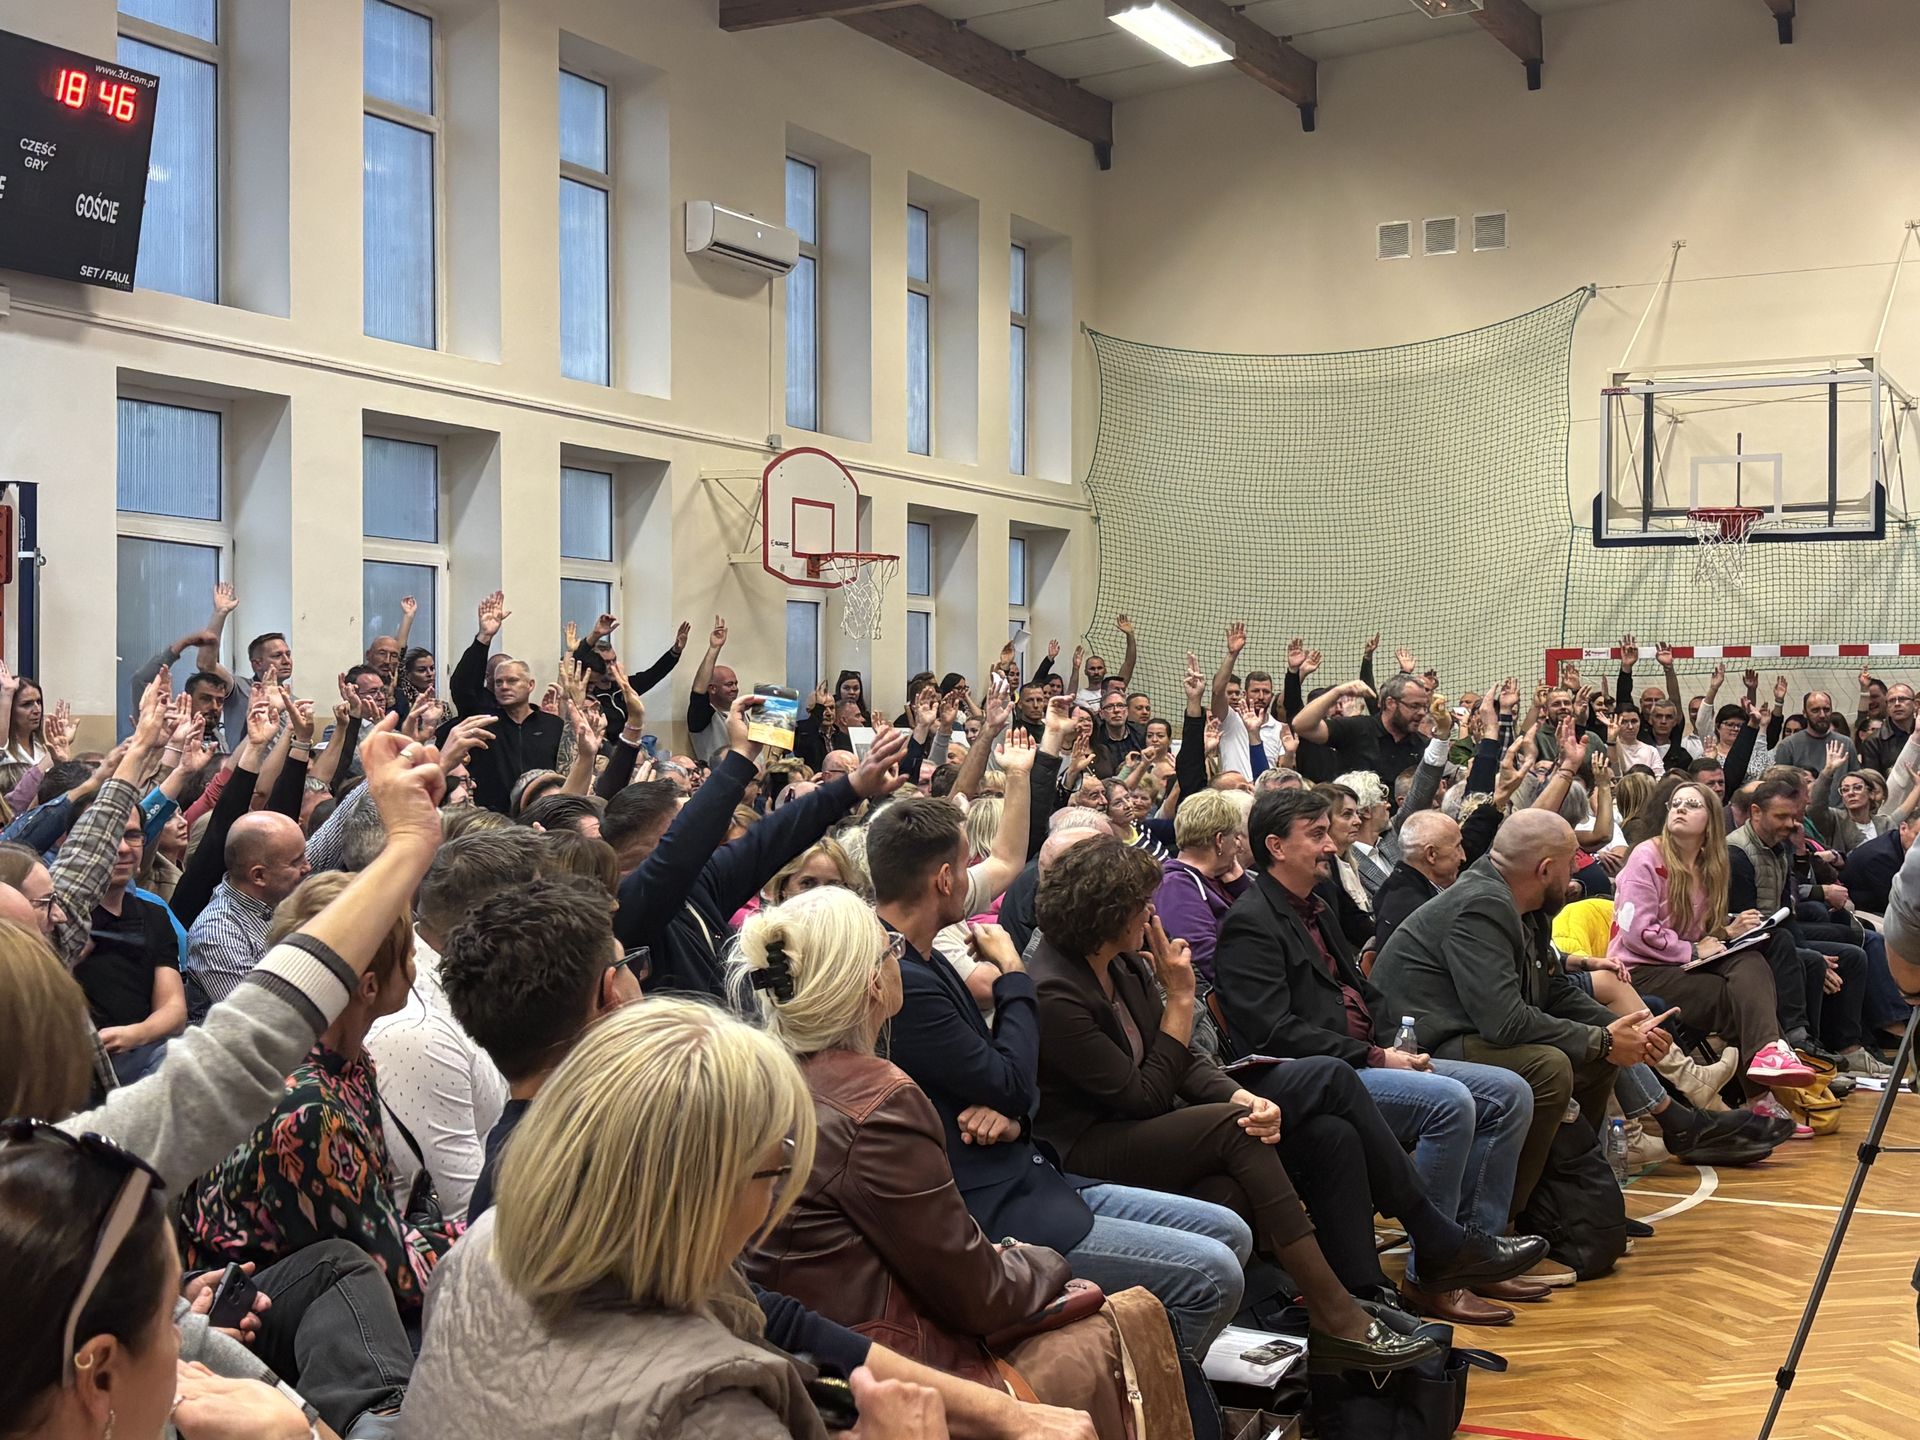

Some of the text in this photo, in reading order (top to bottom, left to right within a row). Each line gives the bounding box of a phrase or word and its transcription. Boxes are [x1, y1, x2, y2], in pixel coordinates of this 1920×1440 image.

[95, 65, 157, 88] www.3d.com.pl
[57, 69, 137, 121] 18 46
[20, 138, 57, 156] CZĘŚĆ
[24, 156, 49, 171] GRY
[75, 191, 120, 224] GOŚCIE
